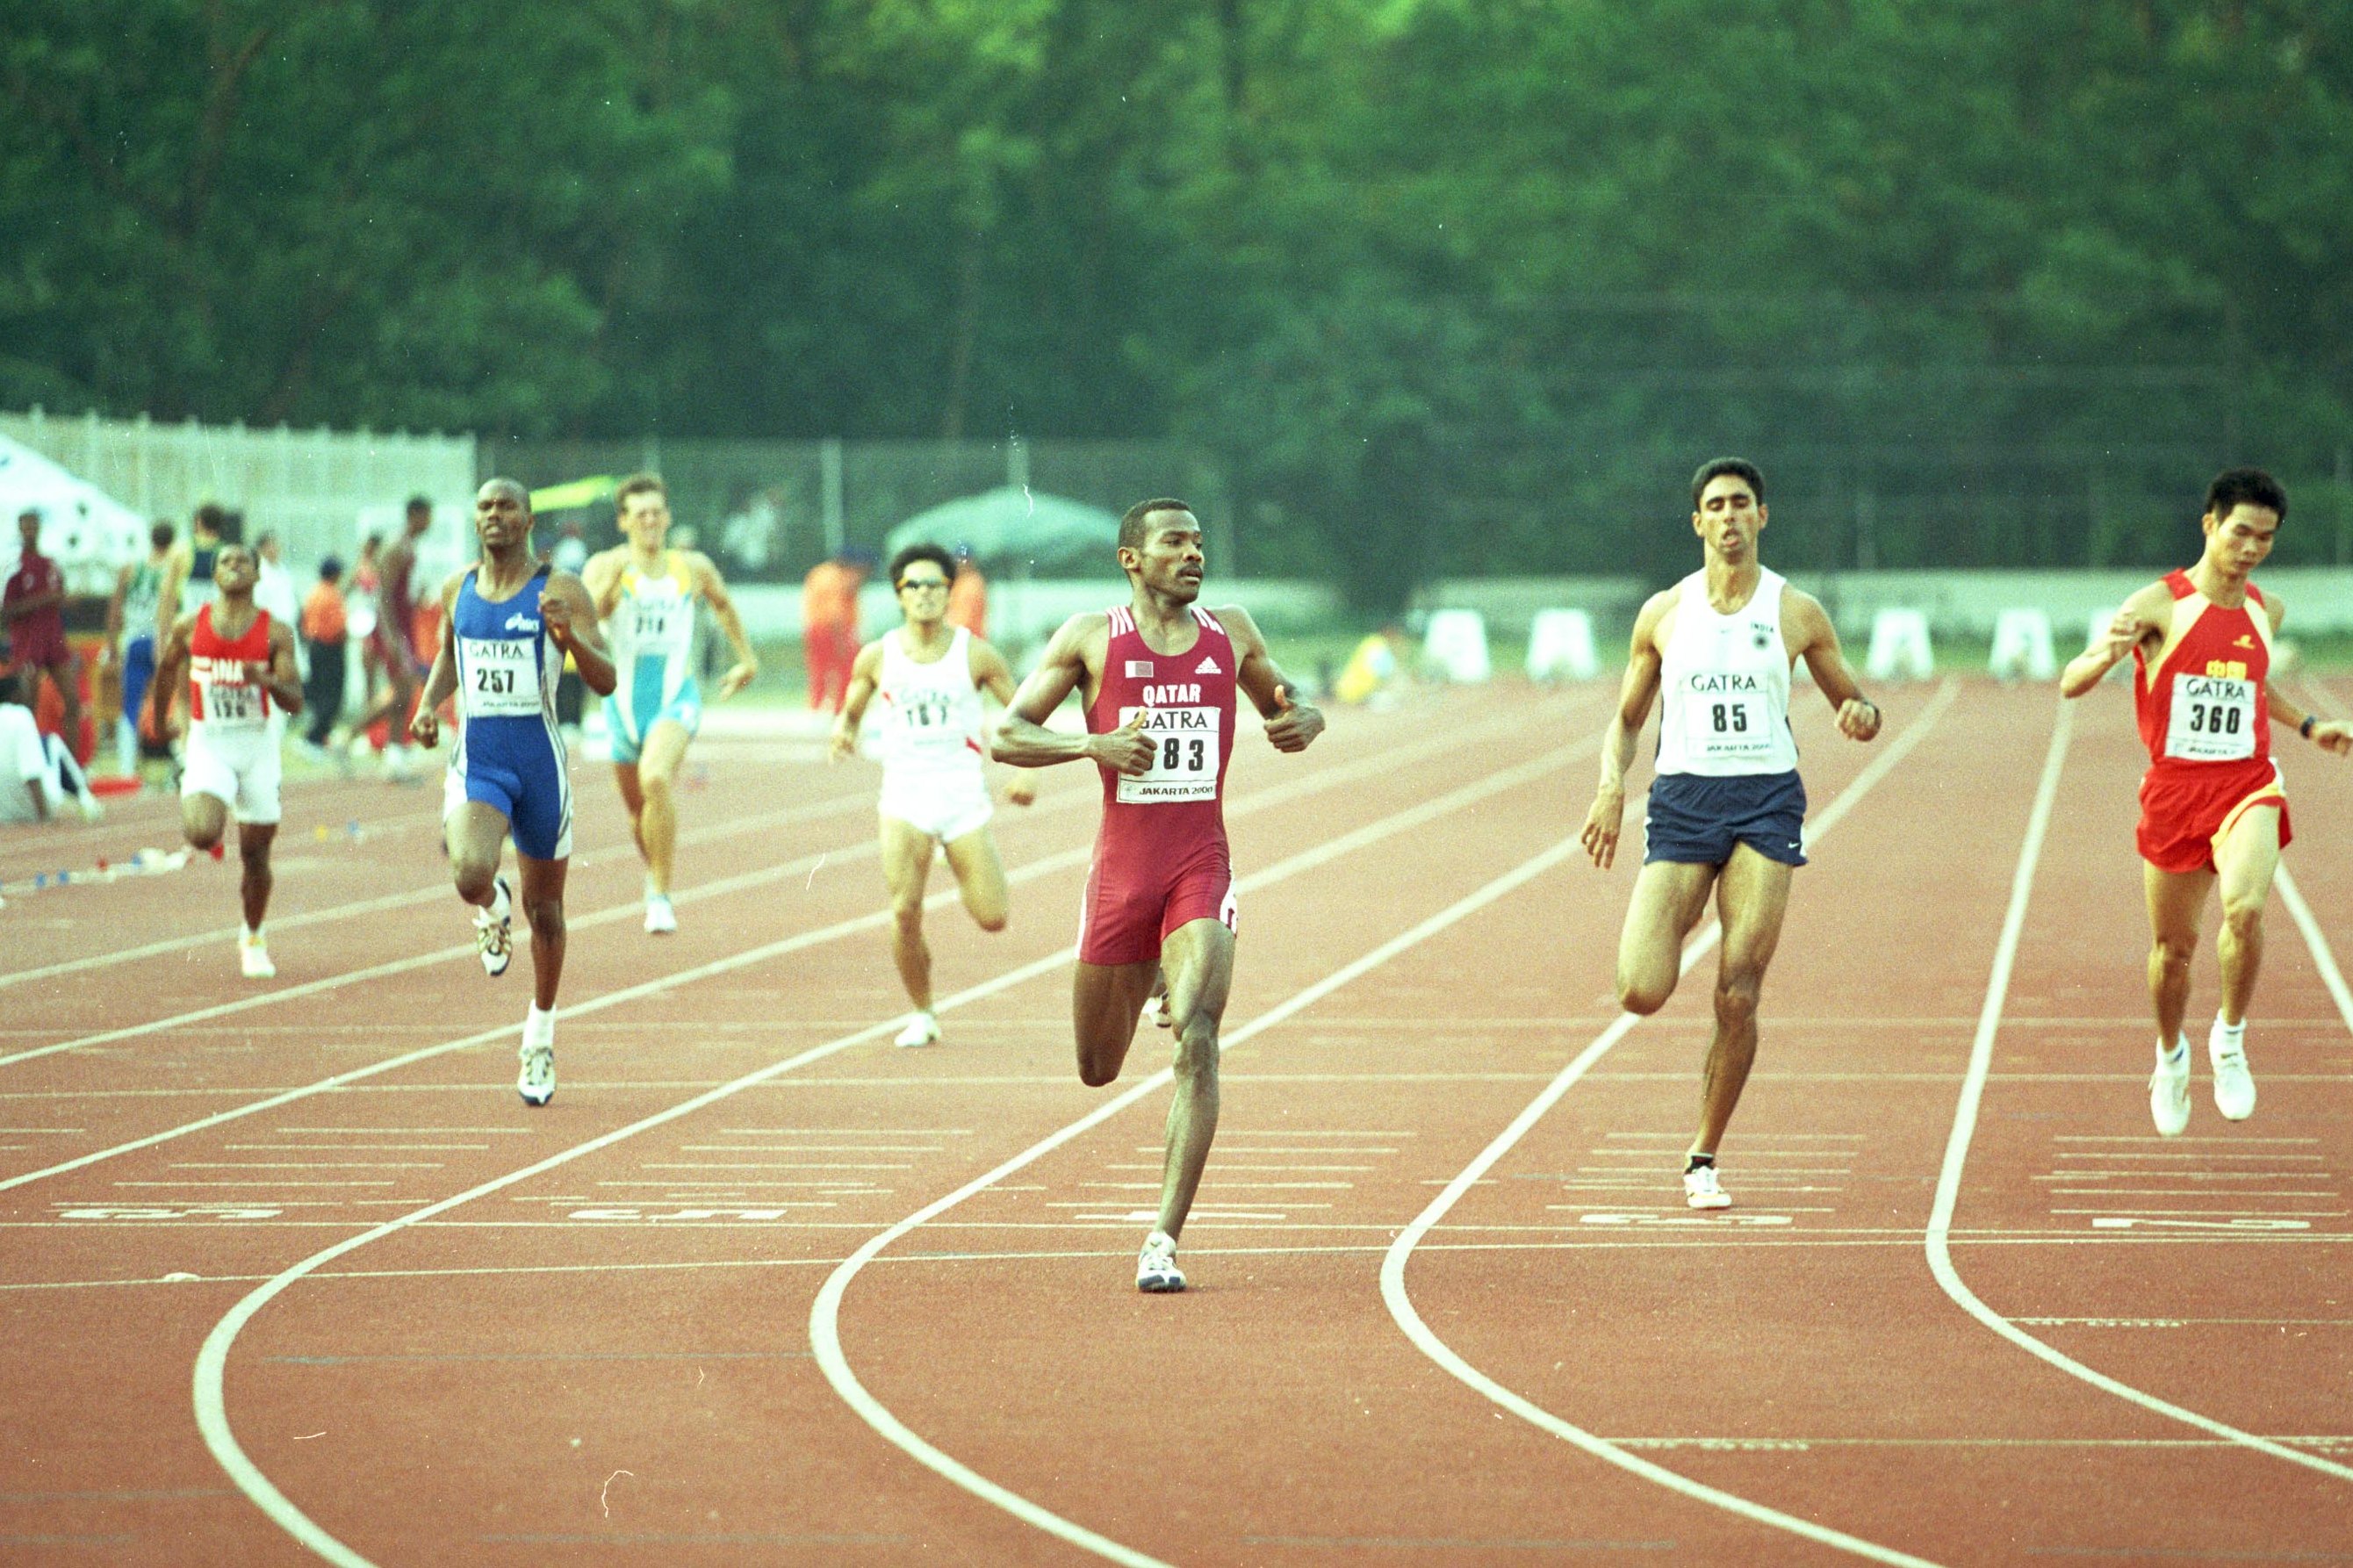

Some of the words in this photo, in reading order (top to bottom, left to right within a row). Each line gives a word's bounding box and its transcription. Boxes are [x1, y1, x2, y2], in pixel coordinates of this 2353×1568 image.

[469, 643, 524, 659] GATRA
[477, 668, 514, 694] 257
[1691, 674, 1757, 691] GATRA
[2186, 679, 2246, 699] GATRA
[1142, 683, 1202, 707] QATAR
[1712, 703, 1748, 732] 85
[2190, 704, 2241, 734] 360
[1140, 787, 1190, 795] JAKARTA
[1191, 786, 1213, 795] 2000
